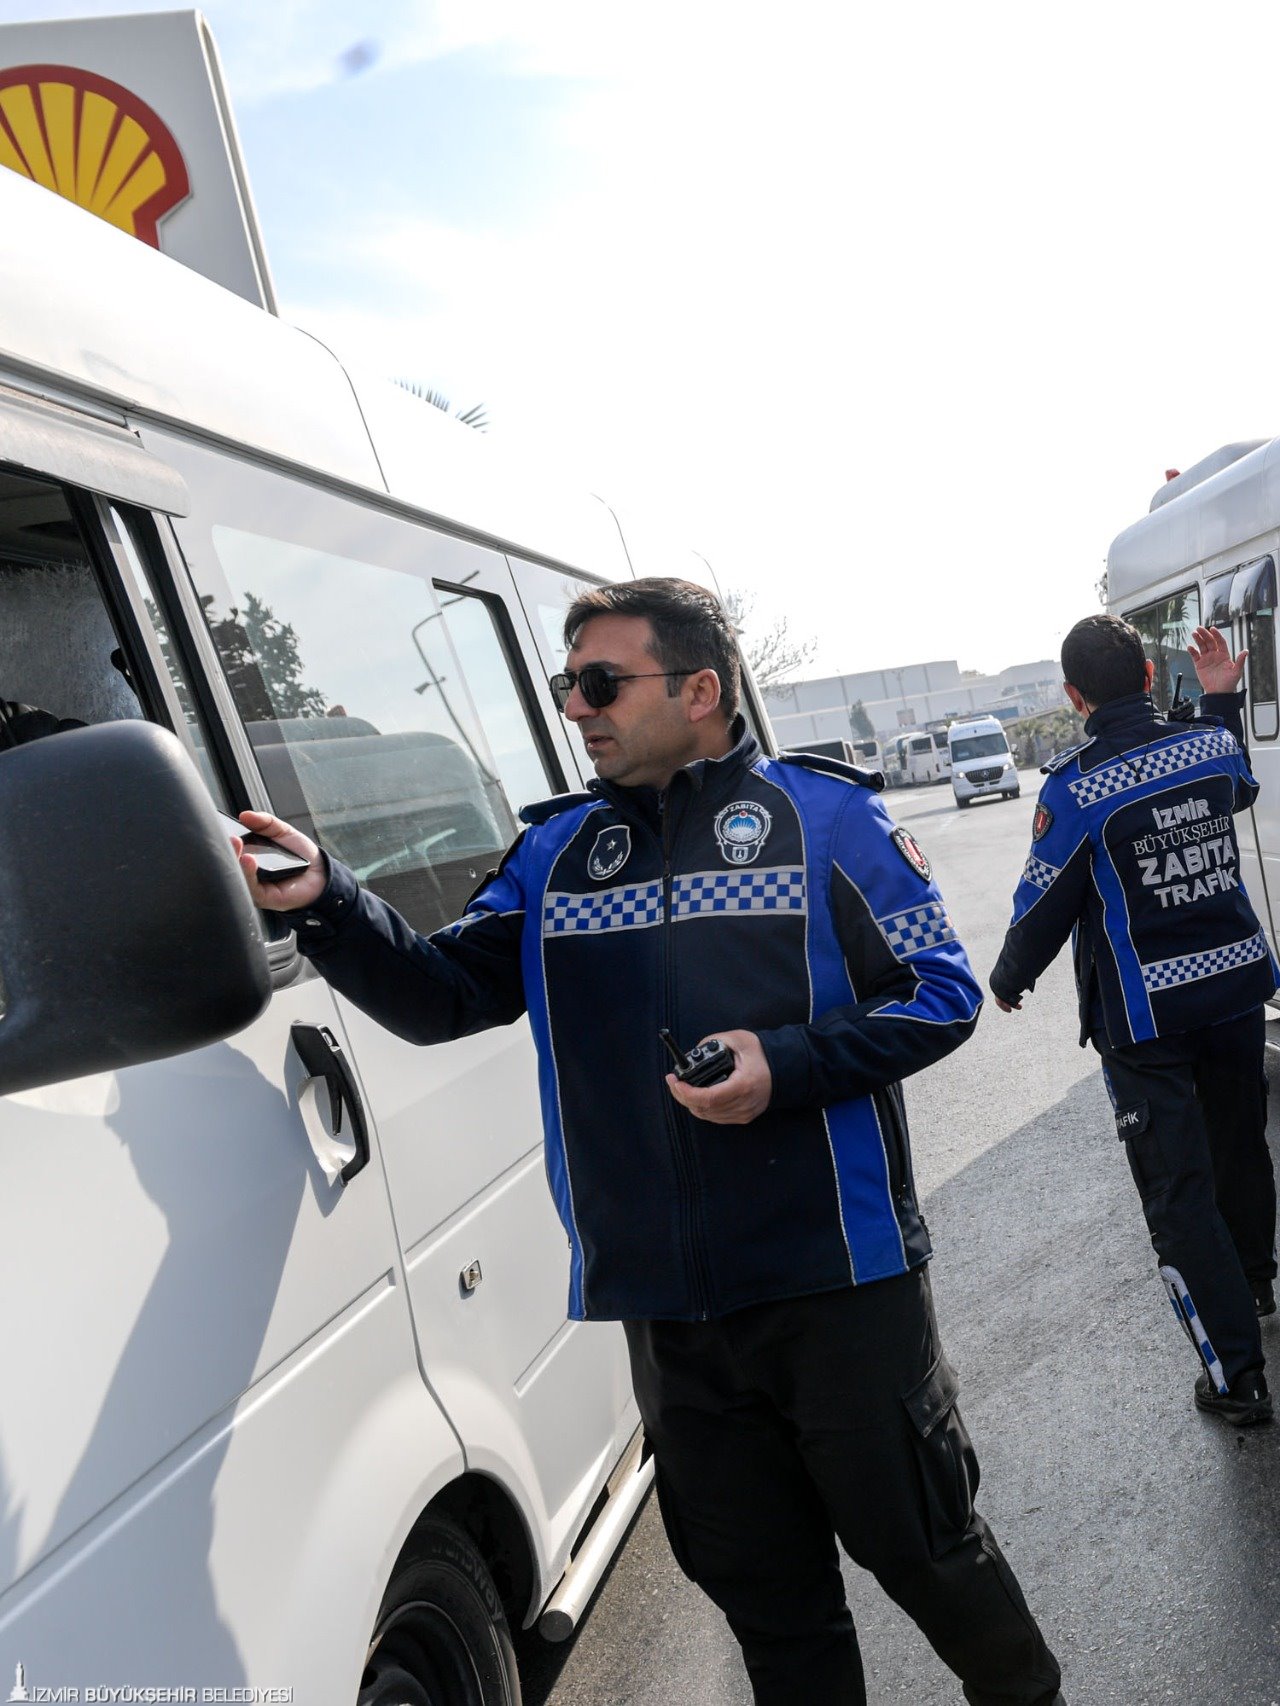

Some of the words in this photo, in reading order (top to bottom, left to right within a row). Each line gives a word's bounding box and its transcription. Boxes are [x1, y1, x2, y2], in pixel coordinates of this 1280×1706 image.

[1151, 797, 1211, 830] İZMİR
[1132, 814, 1231, 856] BÜYÜKŞEHİR
[1137, 835, 1236, 886] ZABITA
[1153, 866, 1239, 908] TRAFİK
